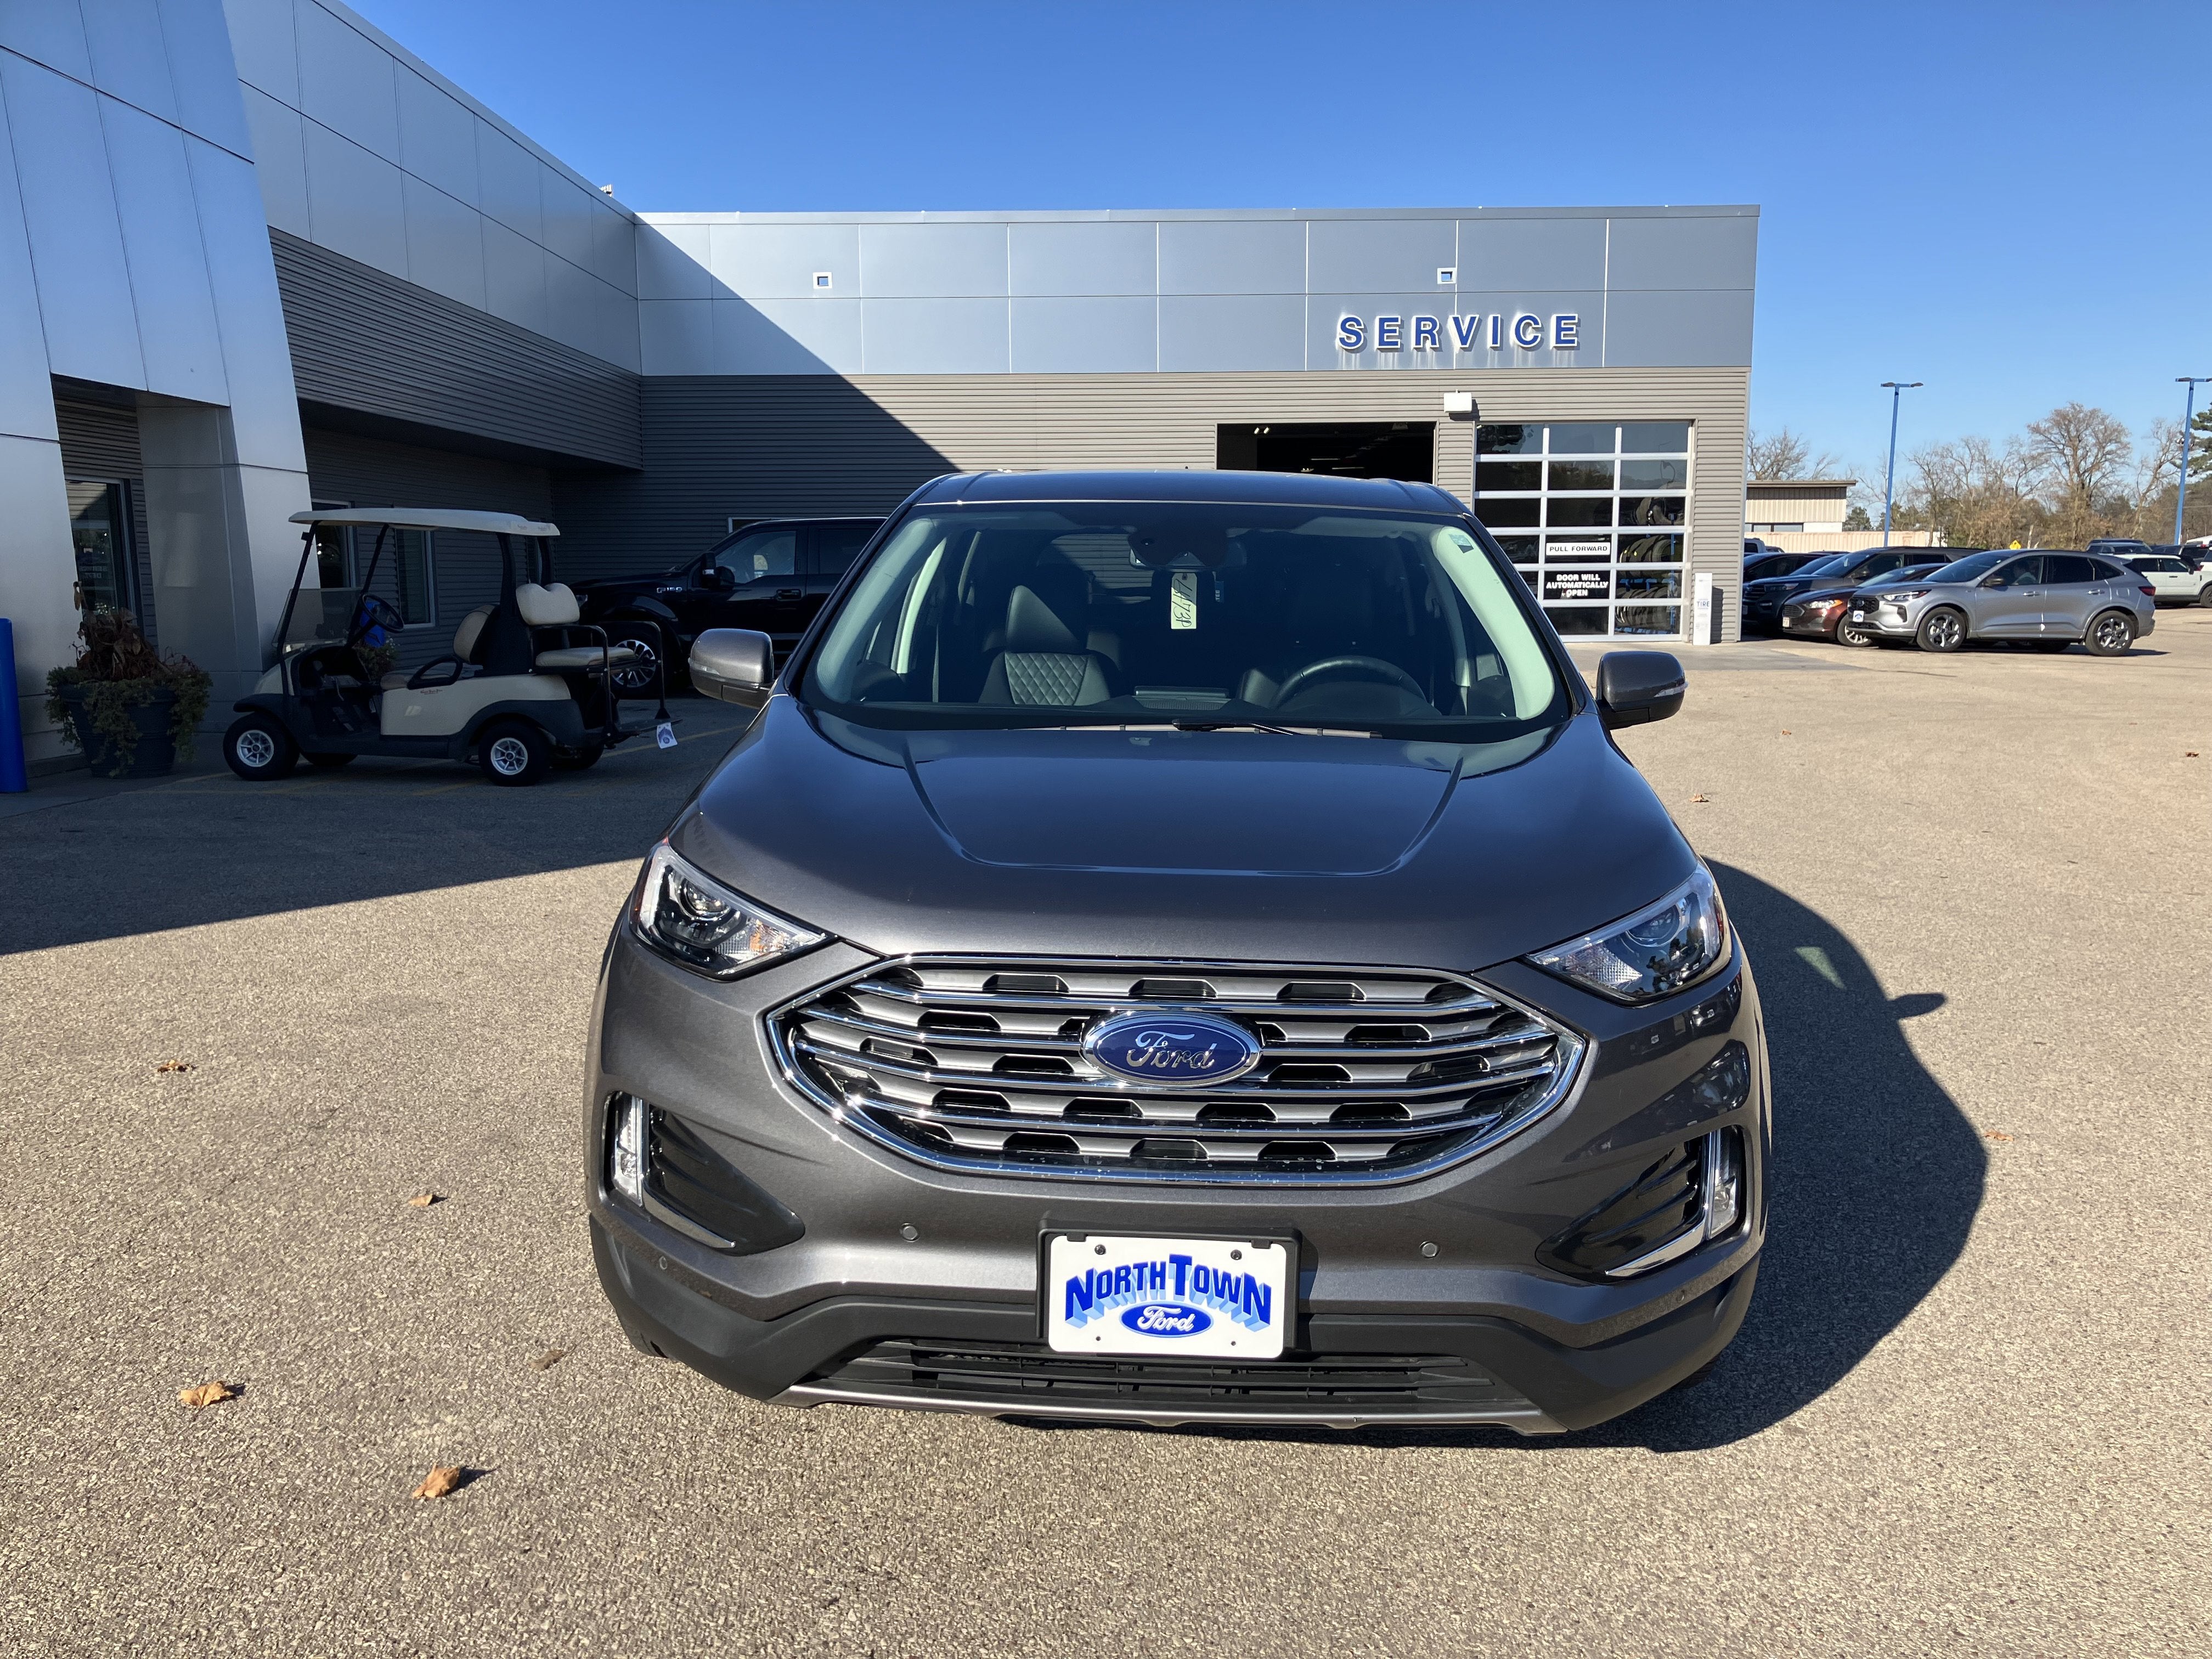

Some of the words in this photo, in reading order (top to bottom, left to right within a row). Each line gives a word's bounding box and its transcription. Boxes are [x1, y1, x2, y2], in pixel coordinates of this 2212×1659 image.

[1337, 314, 1578, 349] SERVICE
[1126, 1030, 1217, 1069] Ford
[1137, 1305, 1195, 1331] Ford
